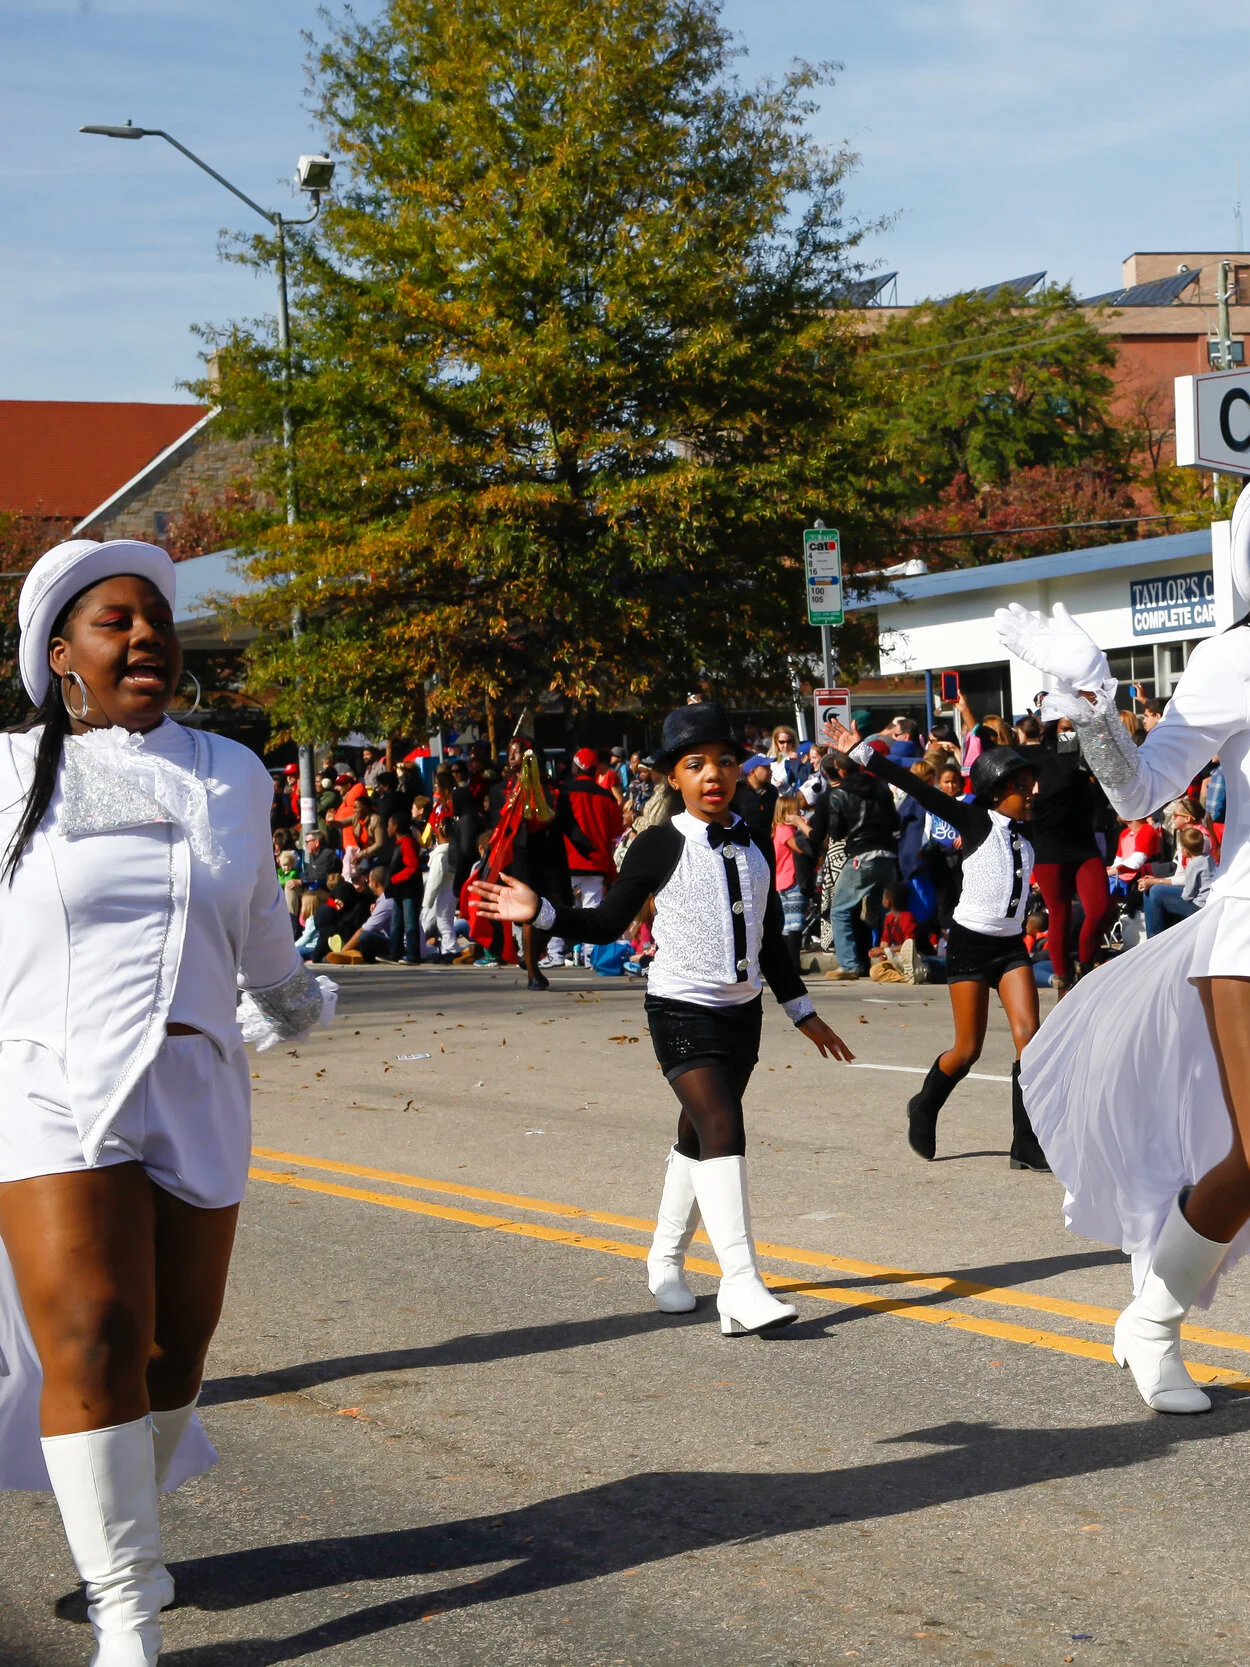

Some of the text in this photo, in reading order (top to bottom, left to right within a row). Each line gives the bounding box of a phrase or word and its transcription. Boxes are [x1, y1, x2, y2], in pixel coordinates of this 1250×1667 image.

[811, 587, 825, 595] 100
[1132, 574, 1215, 610] TAYLOR'S C
[1134, 606, 1192, 631] COMPLETE
